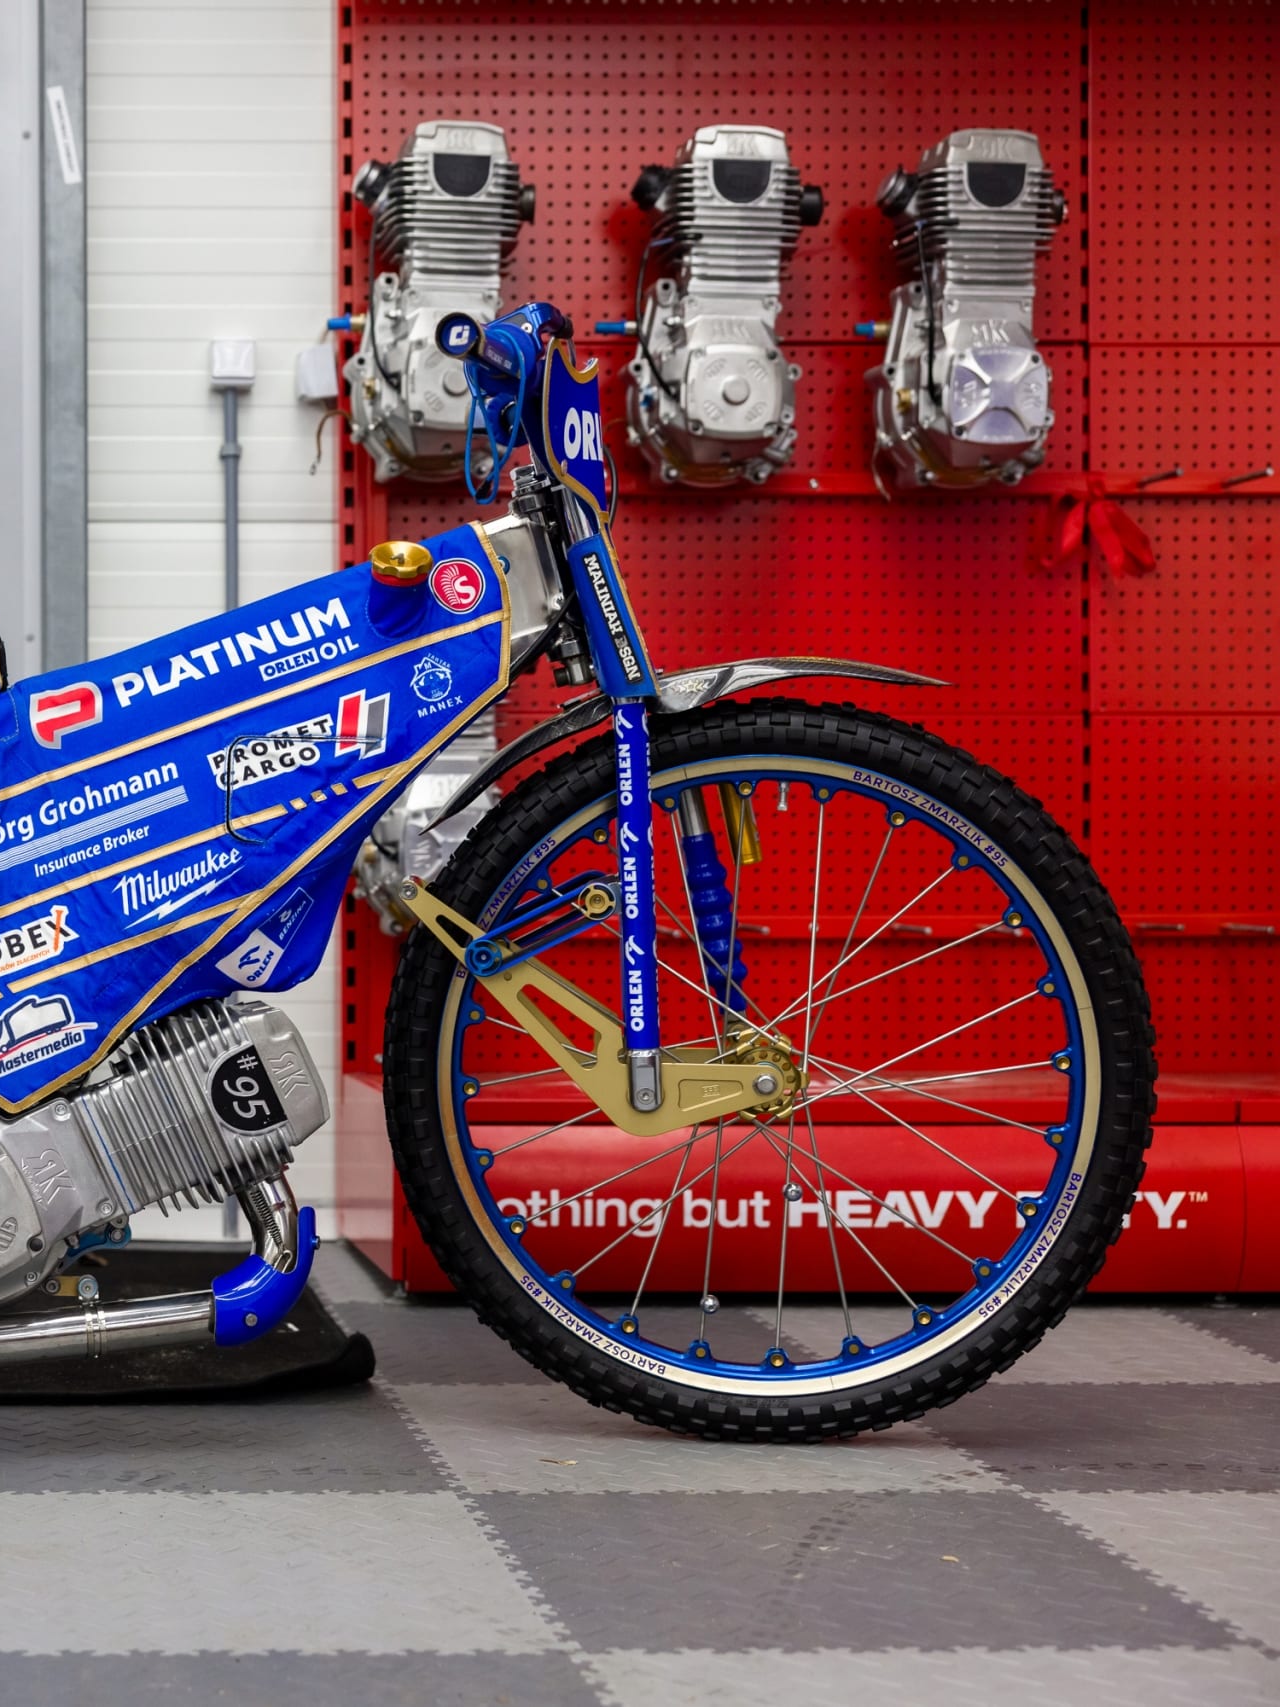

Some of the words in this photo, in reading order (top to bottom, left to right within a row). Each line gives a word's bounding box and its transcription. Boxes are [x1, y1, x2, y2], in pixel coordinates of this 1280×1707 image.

[563, 406, 604, 462] ORL
[584, 553, 623, 635] MALINIAK
[111, 597, 351, 708] PLATINUM
[263, 651, 316, 677] ORLEN
[320, 635, 360, 660] OIL
[417, 695, 463, 718] MANEX
[212, 719, 329, 769] PROMET
[220, 747, 316, 786] CARGO
[39, 761, 179, 826] Grohmann
[619, 743, 633, 806] ORLEN
[853, 770, 919, 803] BARTOSZ
[919, 799, 985, 846] ZMARZLIK
[984, 844, 1008, 867] #95
[34, 844, 101, 878] Insurance
[103, 825, 150, 852] Broker
[486, 859, 535, 917] ZMARZLIK
[534, 836, 557, 859] #95
[111, 847, 244, 916] Milwaukee
[623, 857, 639, 920] ORLEN
[278, 900, 307, 941] BENZINA
[246, 950, 275, 982] ORLEN
[628, 970, 645, 1032] ORLEN
[222, 1054, 271, 1119] #95
[497, 1189, 665, 1238] othing
[682, 1188, 770, 1228] but
[789, 1190, 998, 1229] HEAVY
[1047, 1172, 1082, 1236] BARTOSZ
[520, 1274, 542, 1297] #95
[1001, 1235, 1052, 1297] ZMARZLIK
[542, 1295, 603, 1343] ZMARZLIK
[978, 1295, 1002, 1318] #95
[604, 1343, 666, 1375] BARTOSZ
